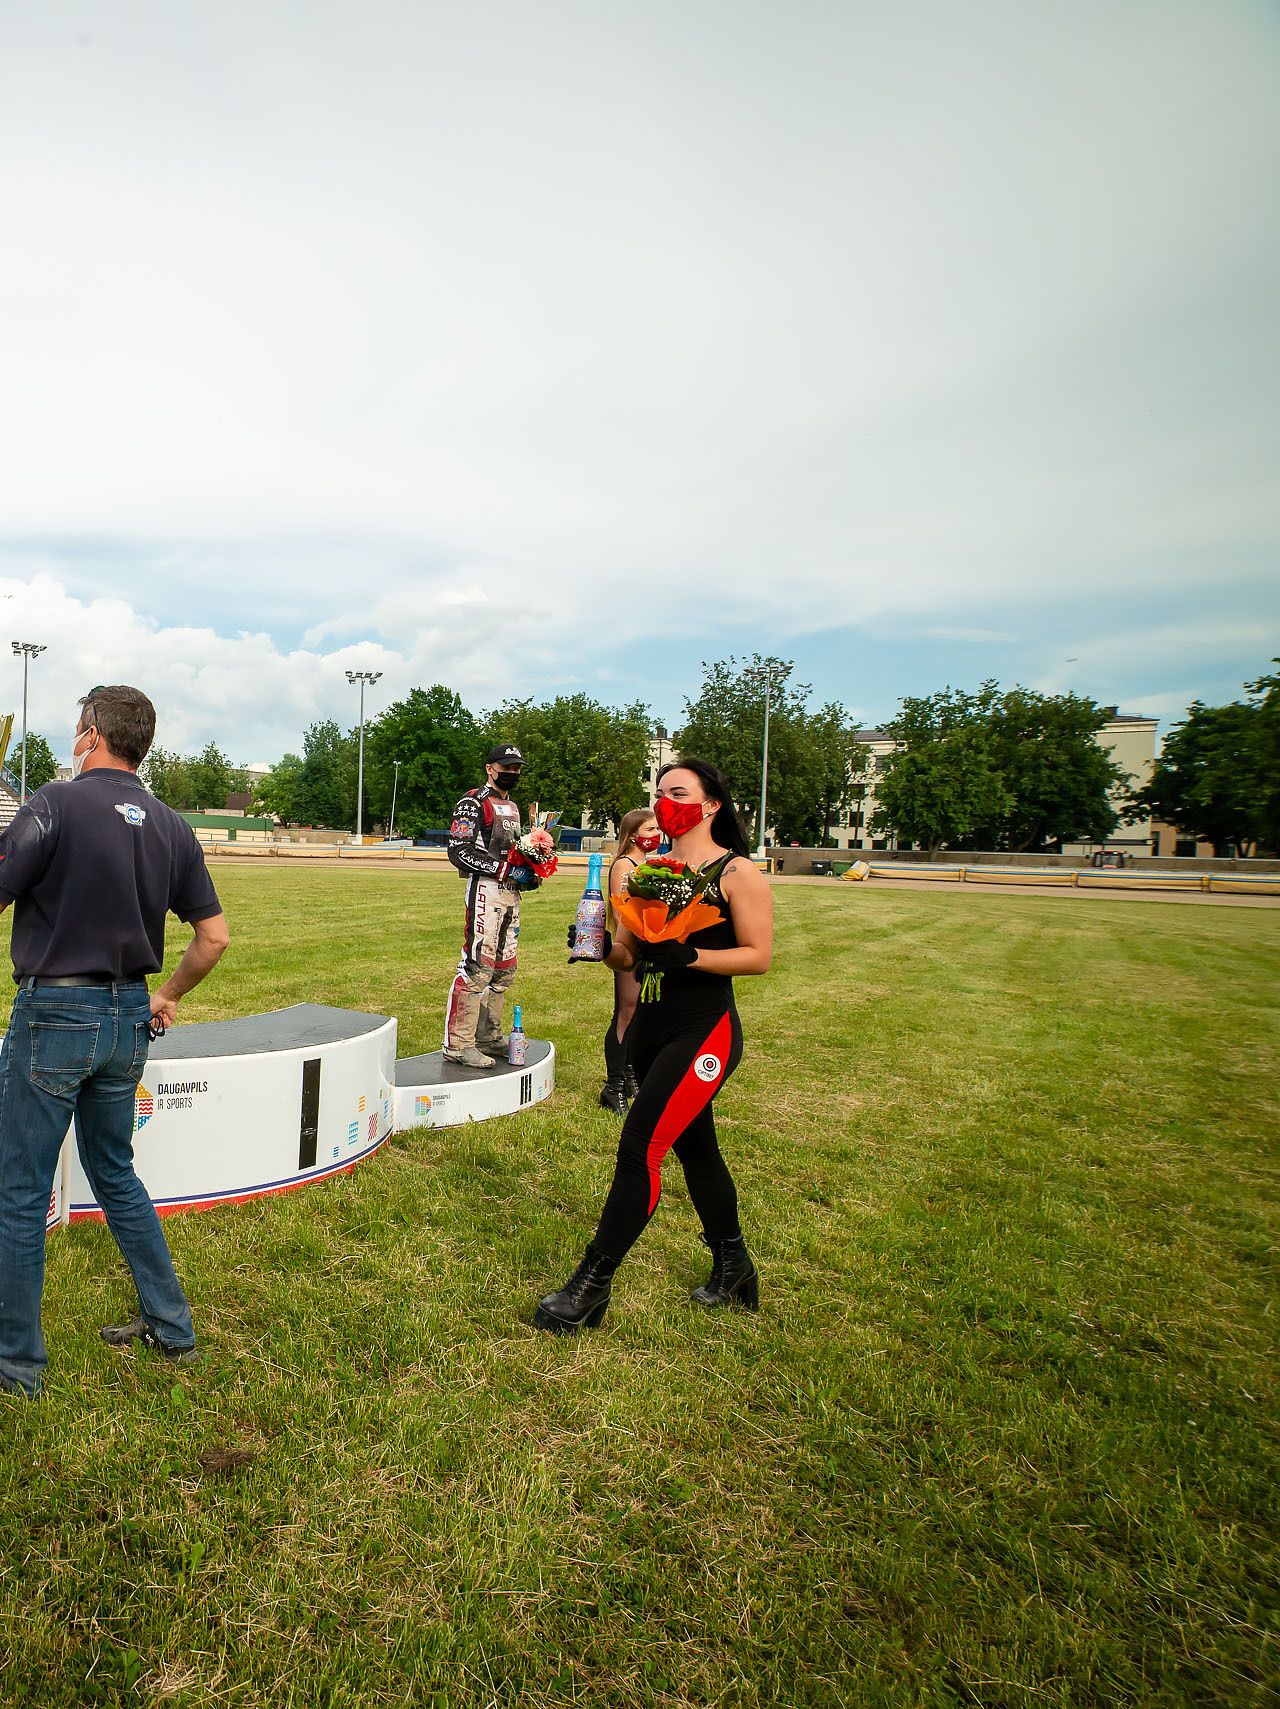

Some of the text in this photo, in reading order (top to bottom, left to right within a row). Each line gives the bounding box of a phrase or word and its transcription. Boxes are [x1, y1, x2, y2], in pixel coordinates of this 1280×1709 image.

[476, 884, 487, 935] LATVIA
[157, 1080, 208, 1095] DAUGAVPILS
[157, 1096, 193, 1111] IR SPORTS
